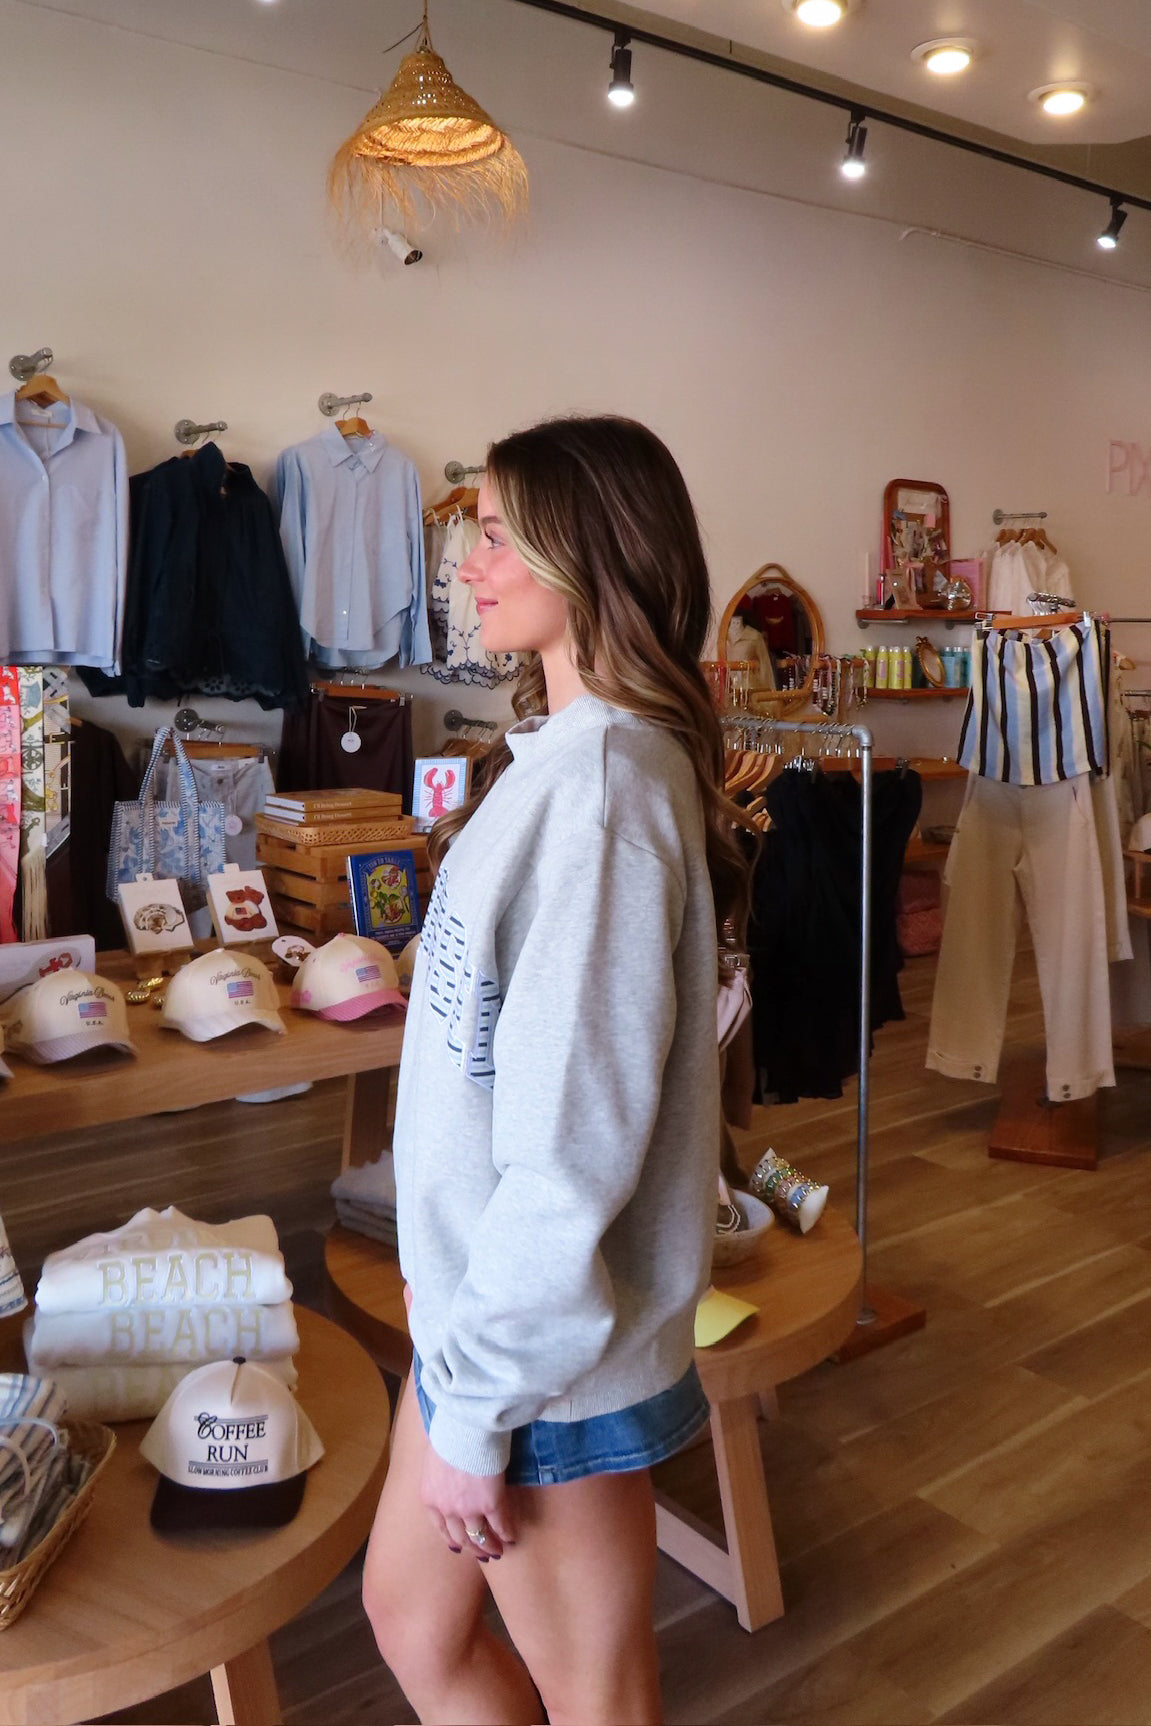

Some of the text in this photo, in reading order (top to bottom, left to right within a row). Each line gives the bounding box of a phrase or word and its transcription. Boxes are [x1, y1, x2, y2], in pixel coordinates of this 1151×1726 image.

[98, 1251, 256, 1306] BEACH
[109, 1308, 263, 1357] BEACH
[197, 1412, 266, 1440] COFFEE
[206, 1443, 249, 1462] RUN
